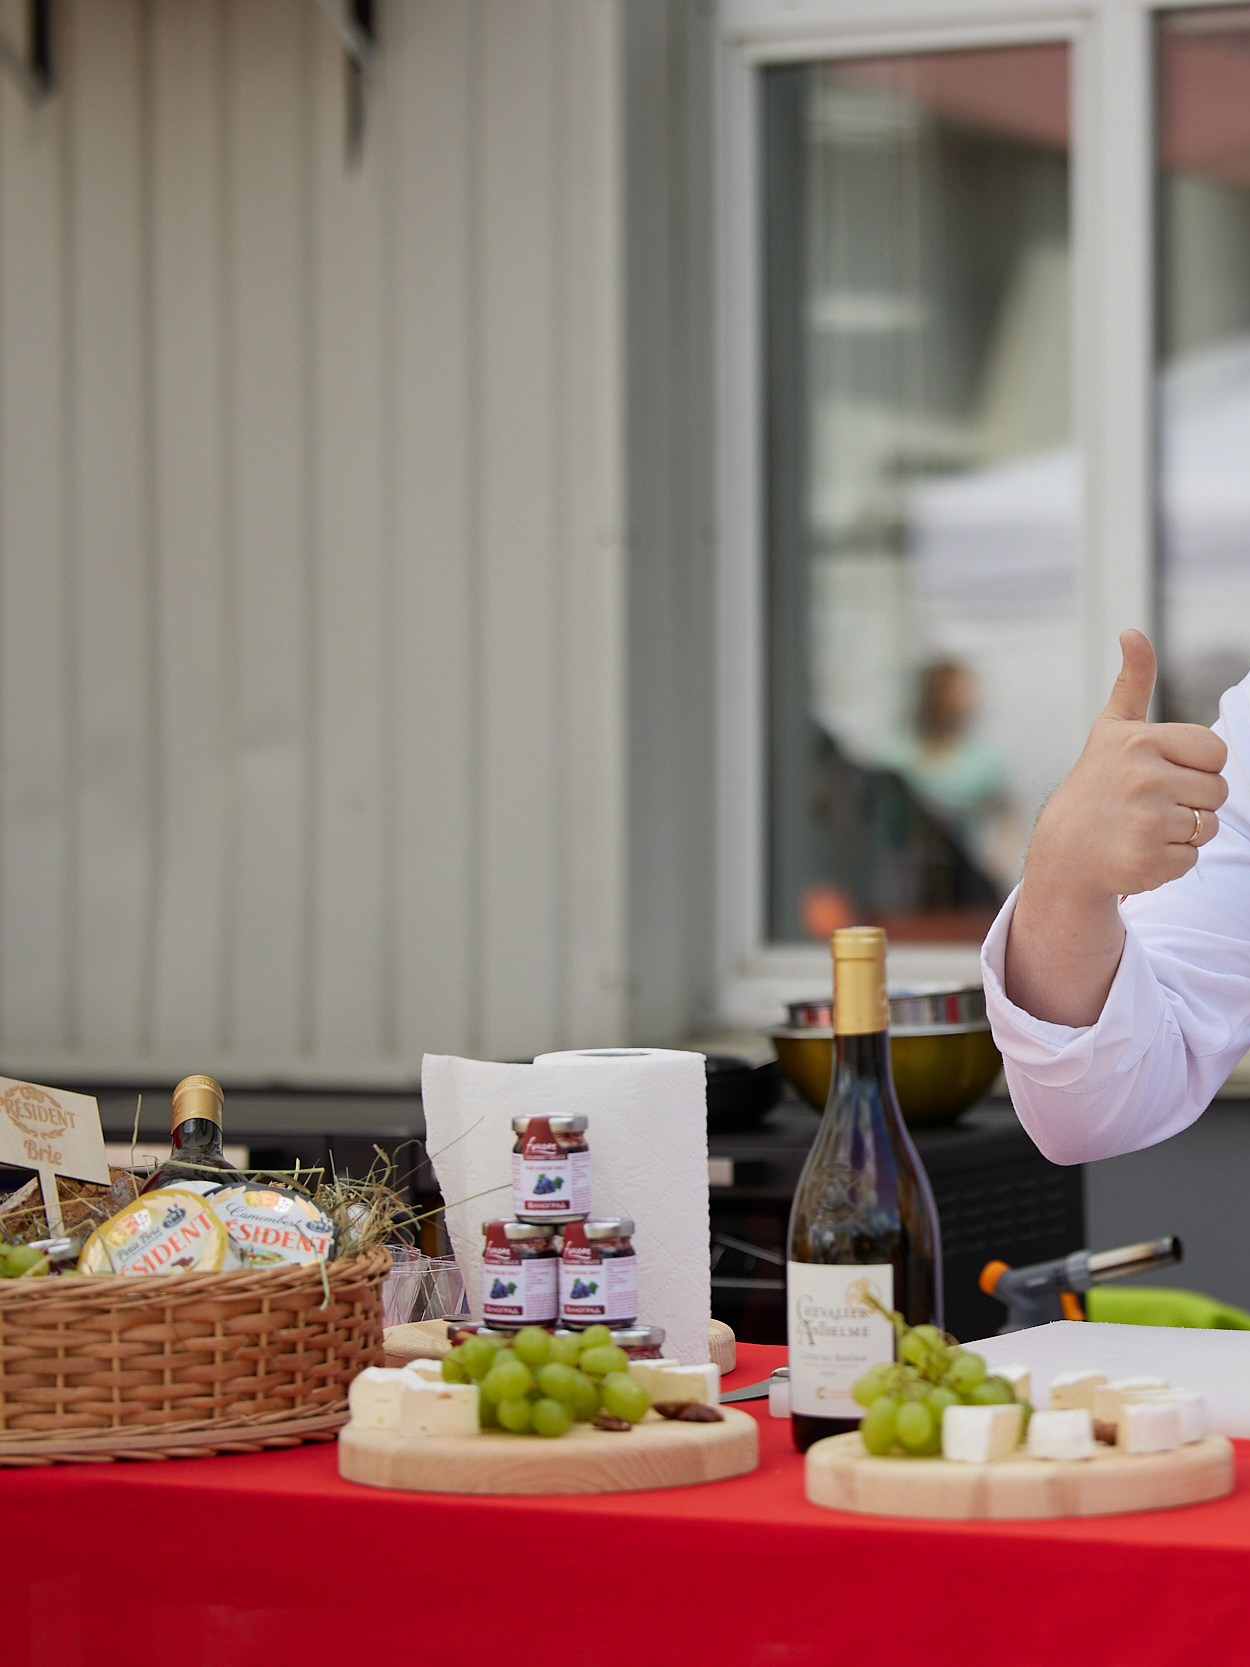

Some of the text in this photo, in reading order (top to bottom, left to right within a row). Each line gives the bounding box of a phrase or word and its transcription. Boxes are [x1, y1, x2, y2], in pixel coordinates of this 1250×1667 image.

[24, 1139, 62, 1166] Brie
[226, 1202, 302, 1227] Camembert
[140, 1226, 164, 1245] Brie
